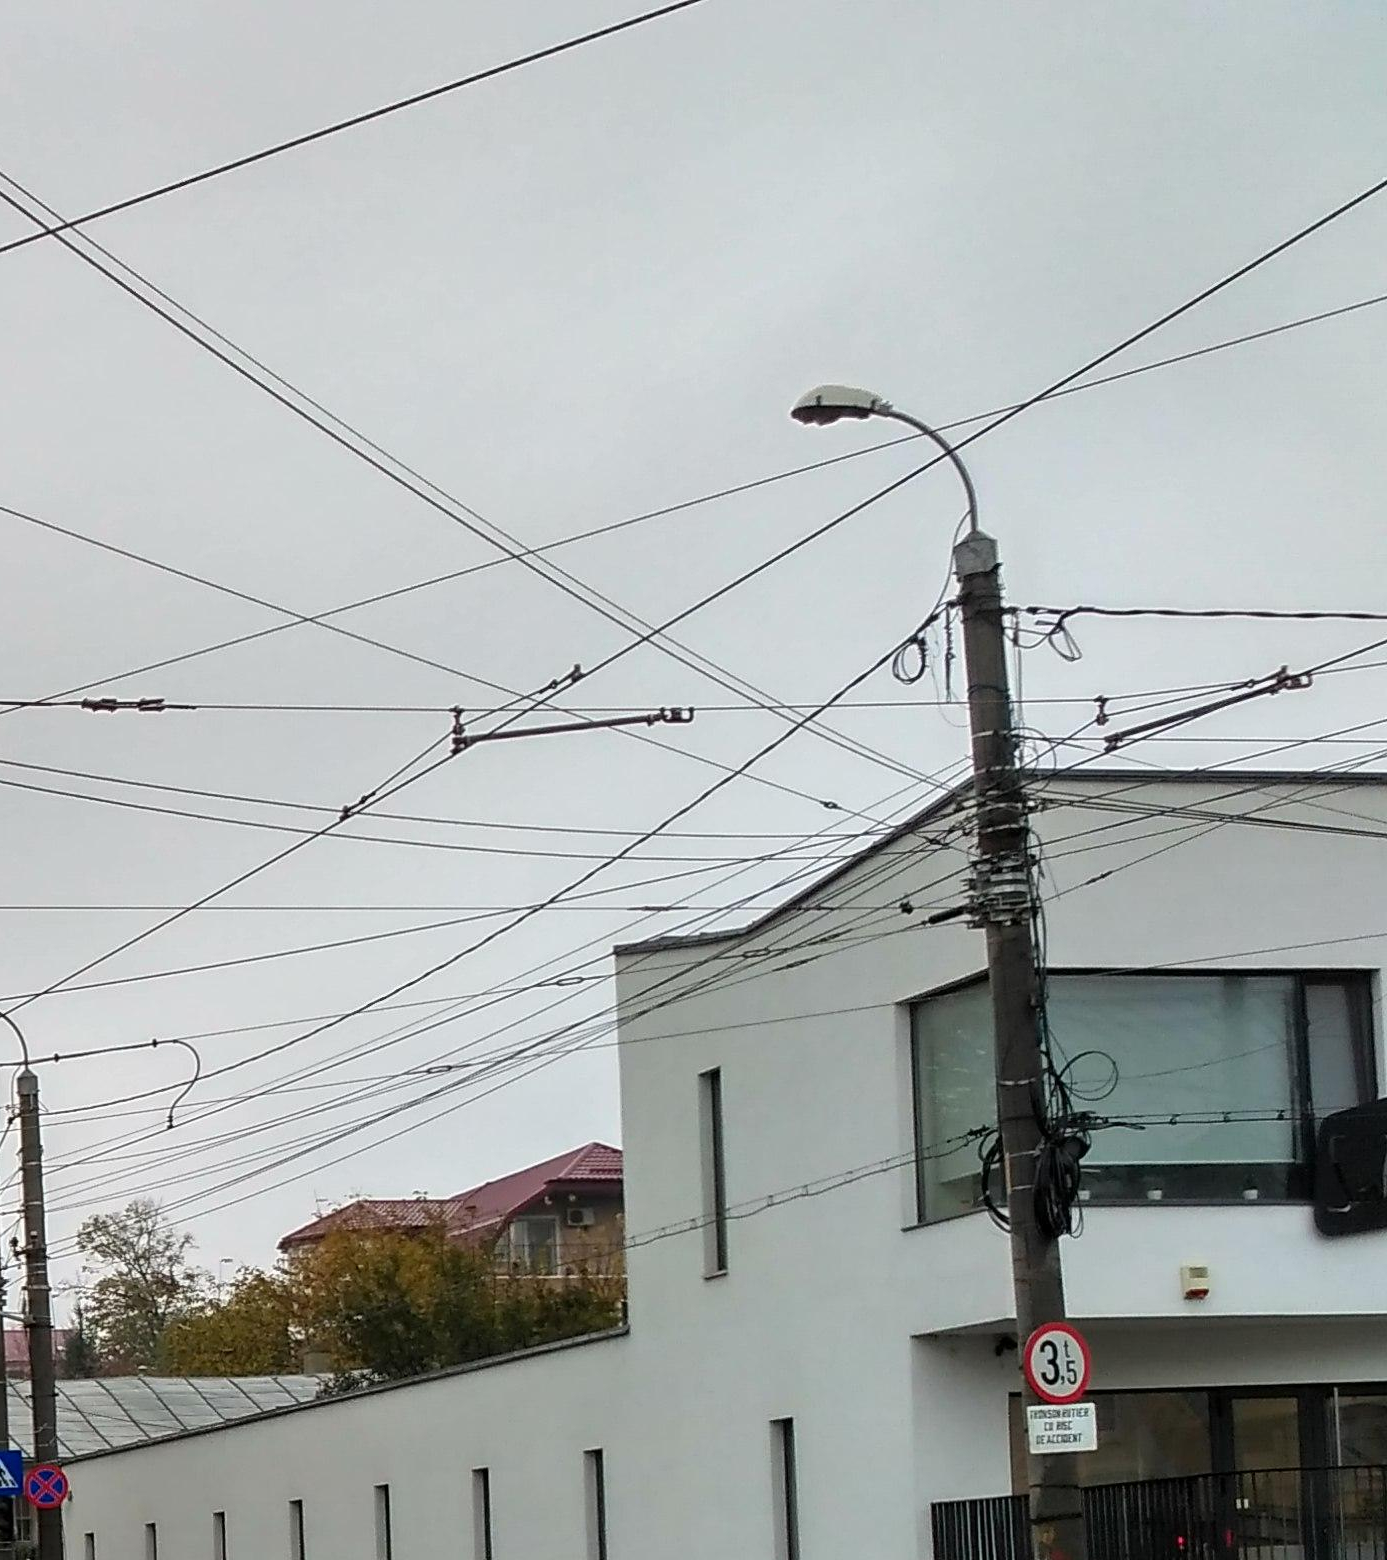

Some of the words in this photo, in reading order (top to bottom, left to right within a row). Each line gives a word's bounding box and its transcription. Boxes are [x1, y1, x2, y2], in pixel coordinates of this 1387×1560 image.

[1044, 1421, 1054, 1431] CU
[1036, 1434, 1046, 1445] DE
[1047, 1432, 1082, 1444] ACCIDENT
